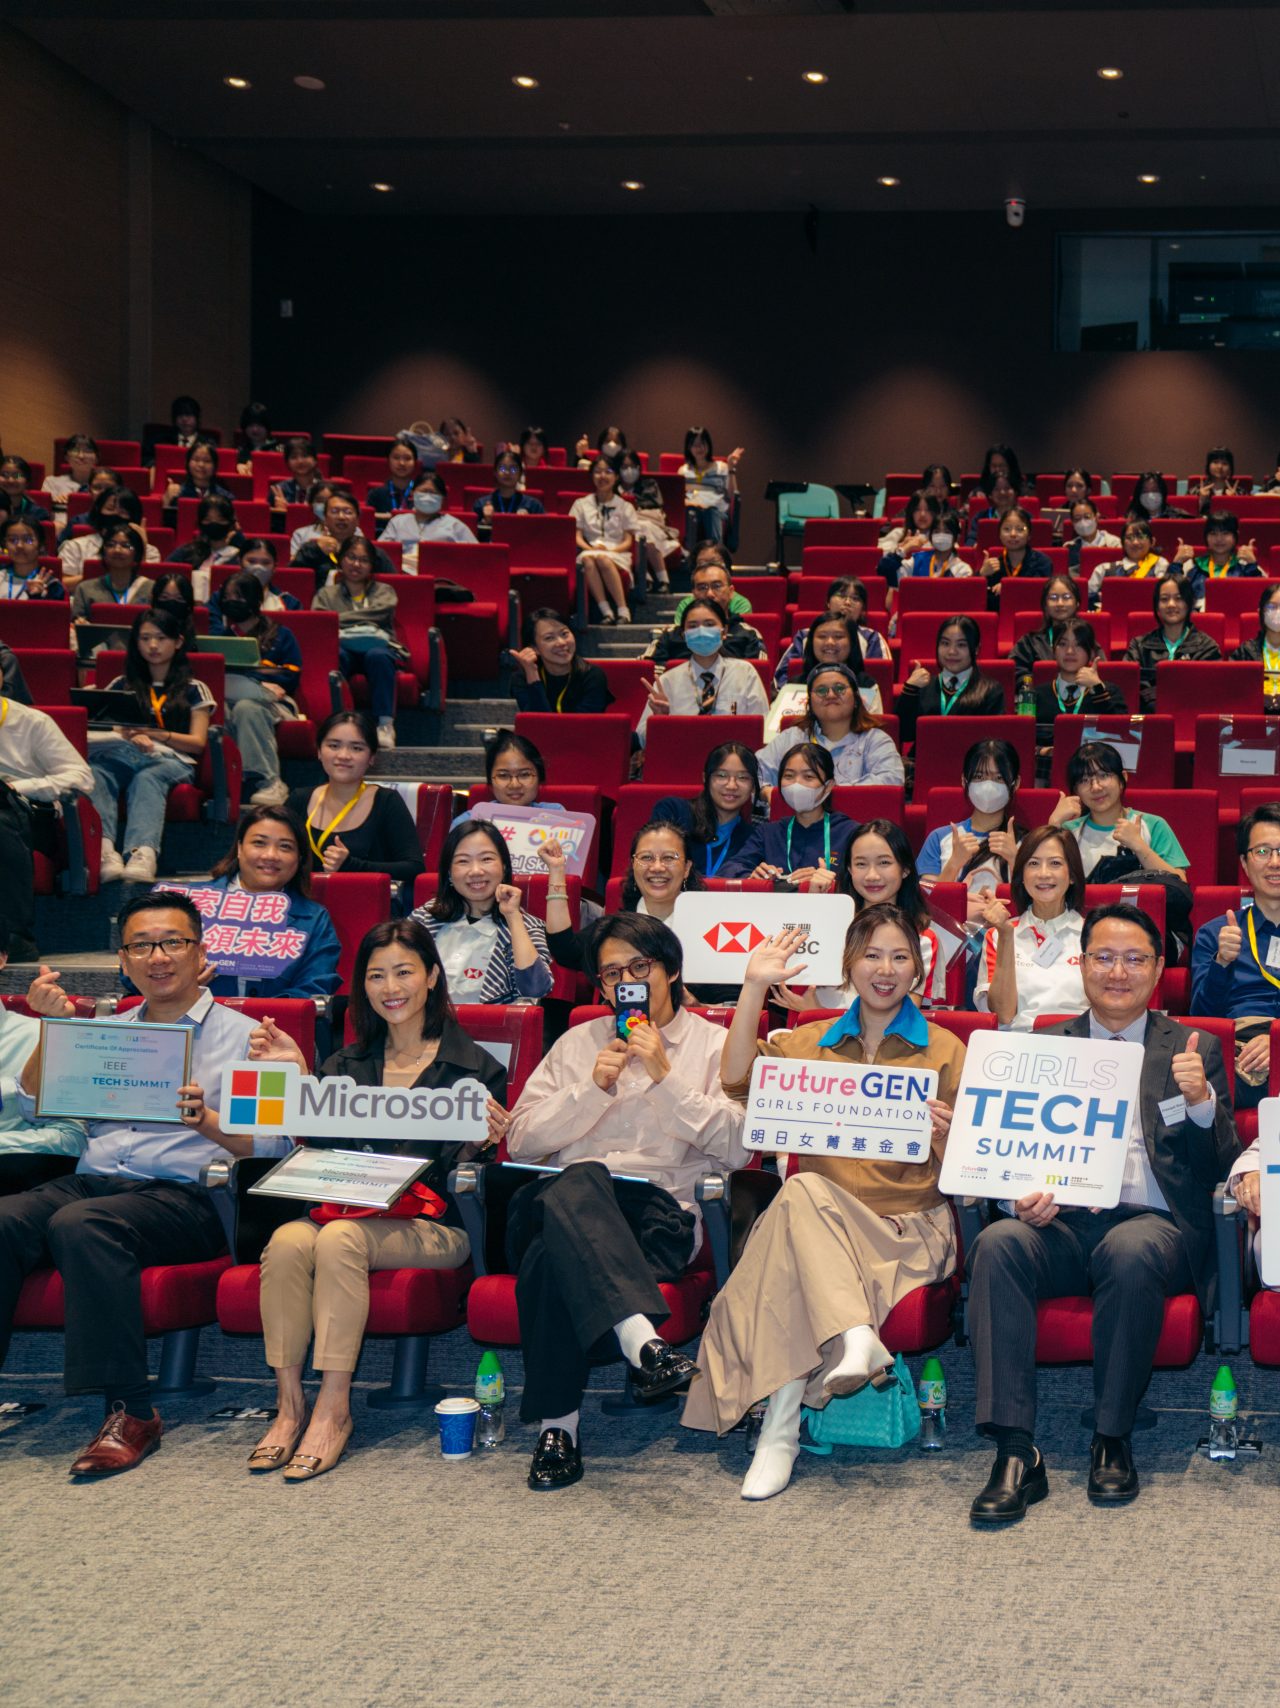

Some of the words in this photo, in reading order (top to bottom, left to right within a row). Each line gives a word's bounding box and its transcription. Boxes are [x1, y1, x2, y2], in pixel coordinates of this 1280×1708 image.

[153, 884, 290, 924] 索自我
[202, 923, 307, 960] 領未來
[75, 1043, 108, 1051] Certificate
[118, 1046, 158, 1054] Appreciation
[103, 1061, 127, 1071] IEEE
[982, 1050, 1120, 1091] GIRLS
[92, 1077, 121, 1086] TECH
[124, 1079, 171, 1089] SUMMIT
[759, 1064, 930, 1102] FutureGEN
[299, 1081, 484, 1123] Microsoft
[756, 1098, 803, 1111] GIRLS
[813, 1102, 926, 1121] FOUNDATION
[965, 1087, 1129, 1139] TECH
[751, 1129, 921, 1156] 明日女菁基金會
[976, 1137, 1096, 1164] SUMMIT
[318, 1176, 344, 1184] TECH
[345, 1178, 389, 1188] SUMMIT
